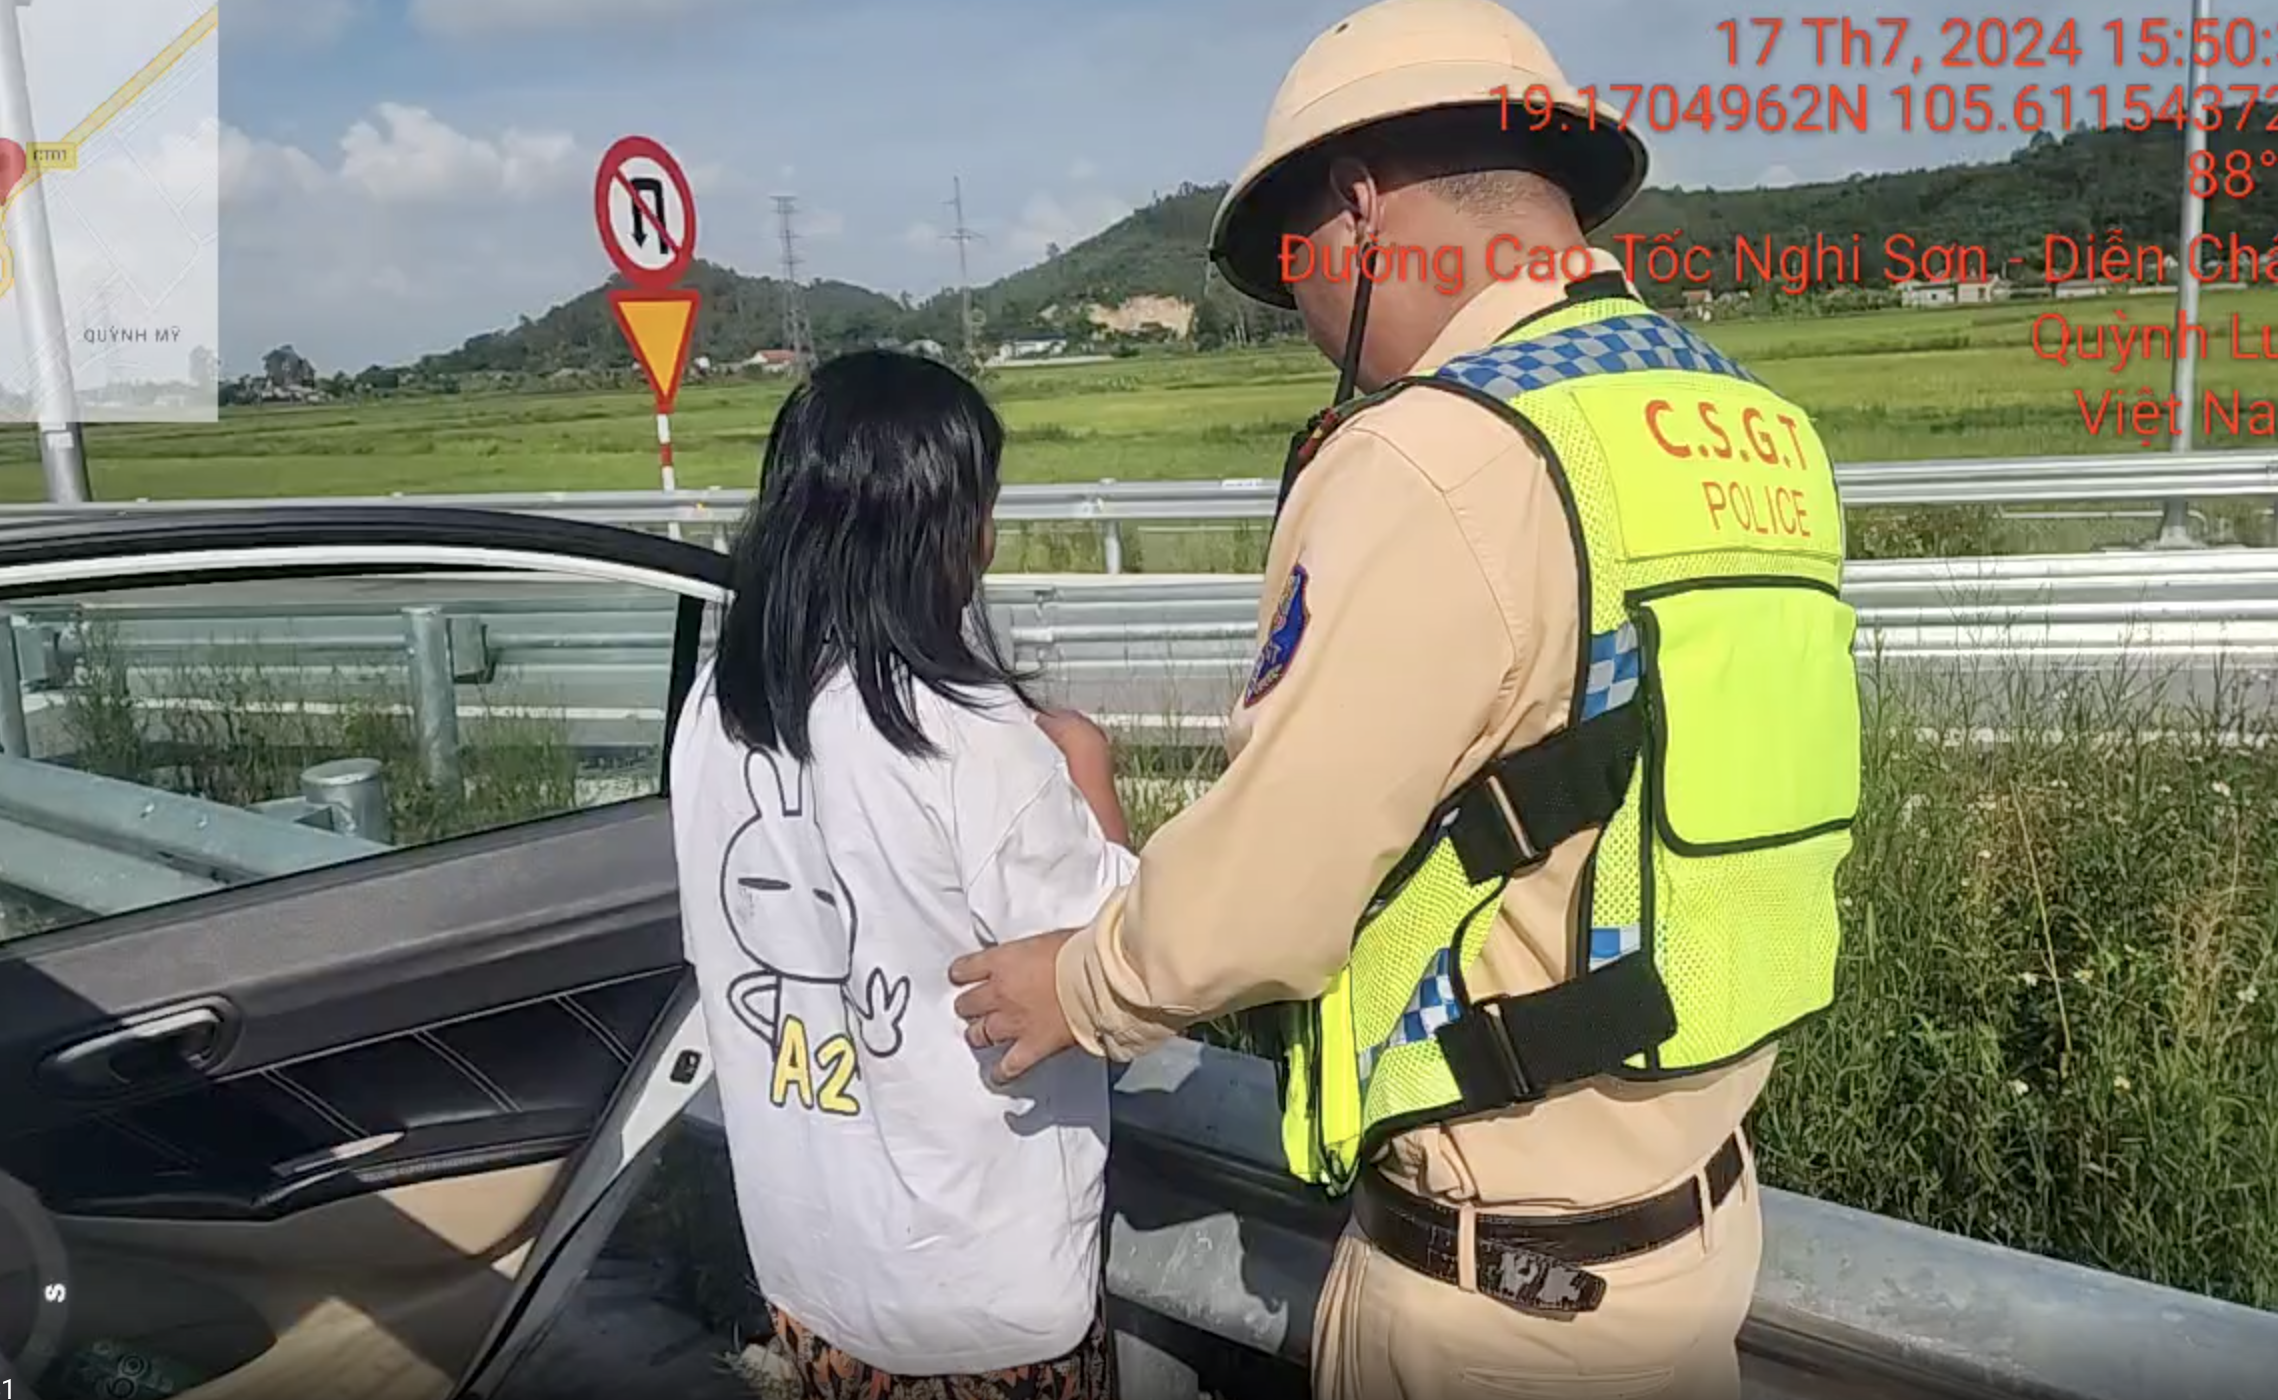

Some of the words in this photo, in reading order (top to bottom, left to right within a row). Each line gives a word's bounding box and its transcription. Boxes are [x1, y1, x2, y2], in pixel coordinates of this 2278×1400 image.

[1645, 399, 1807, 471] C.S.G.T
[1702, 481, 1811, 537] POLICE
[770, 1014, 861, 1116] A2
